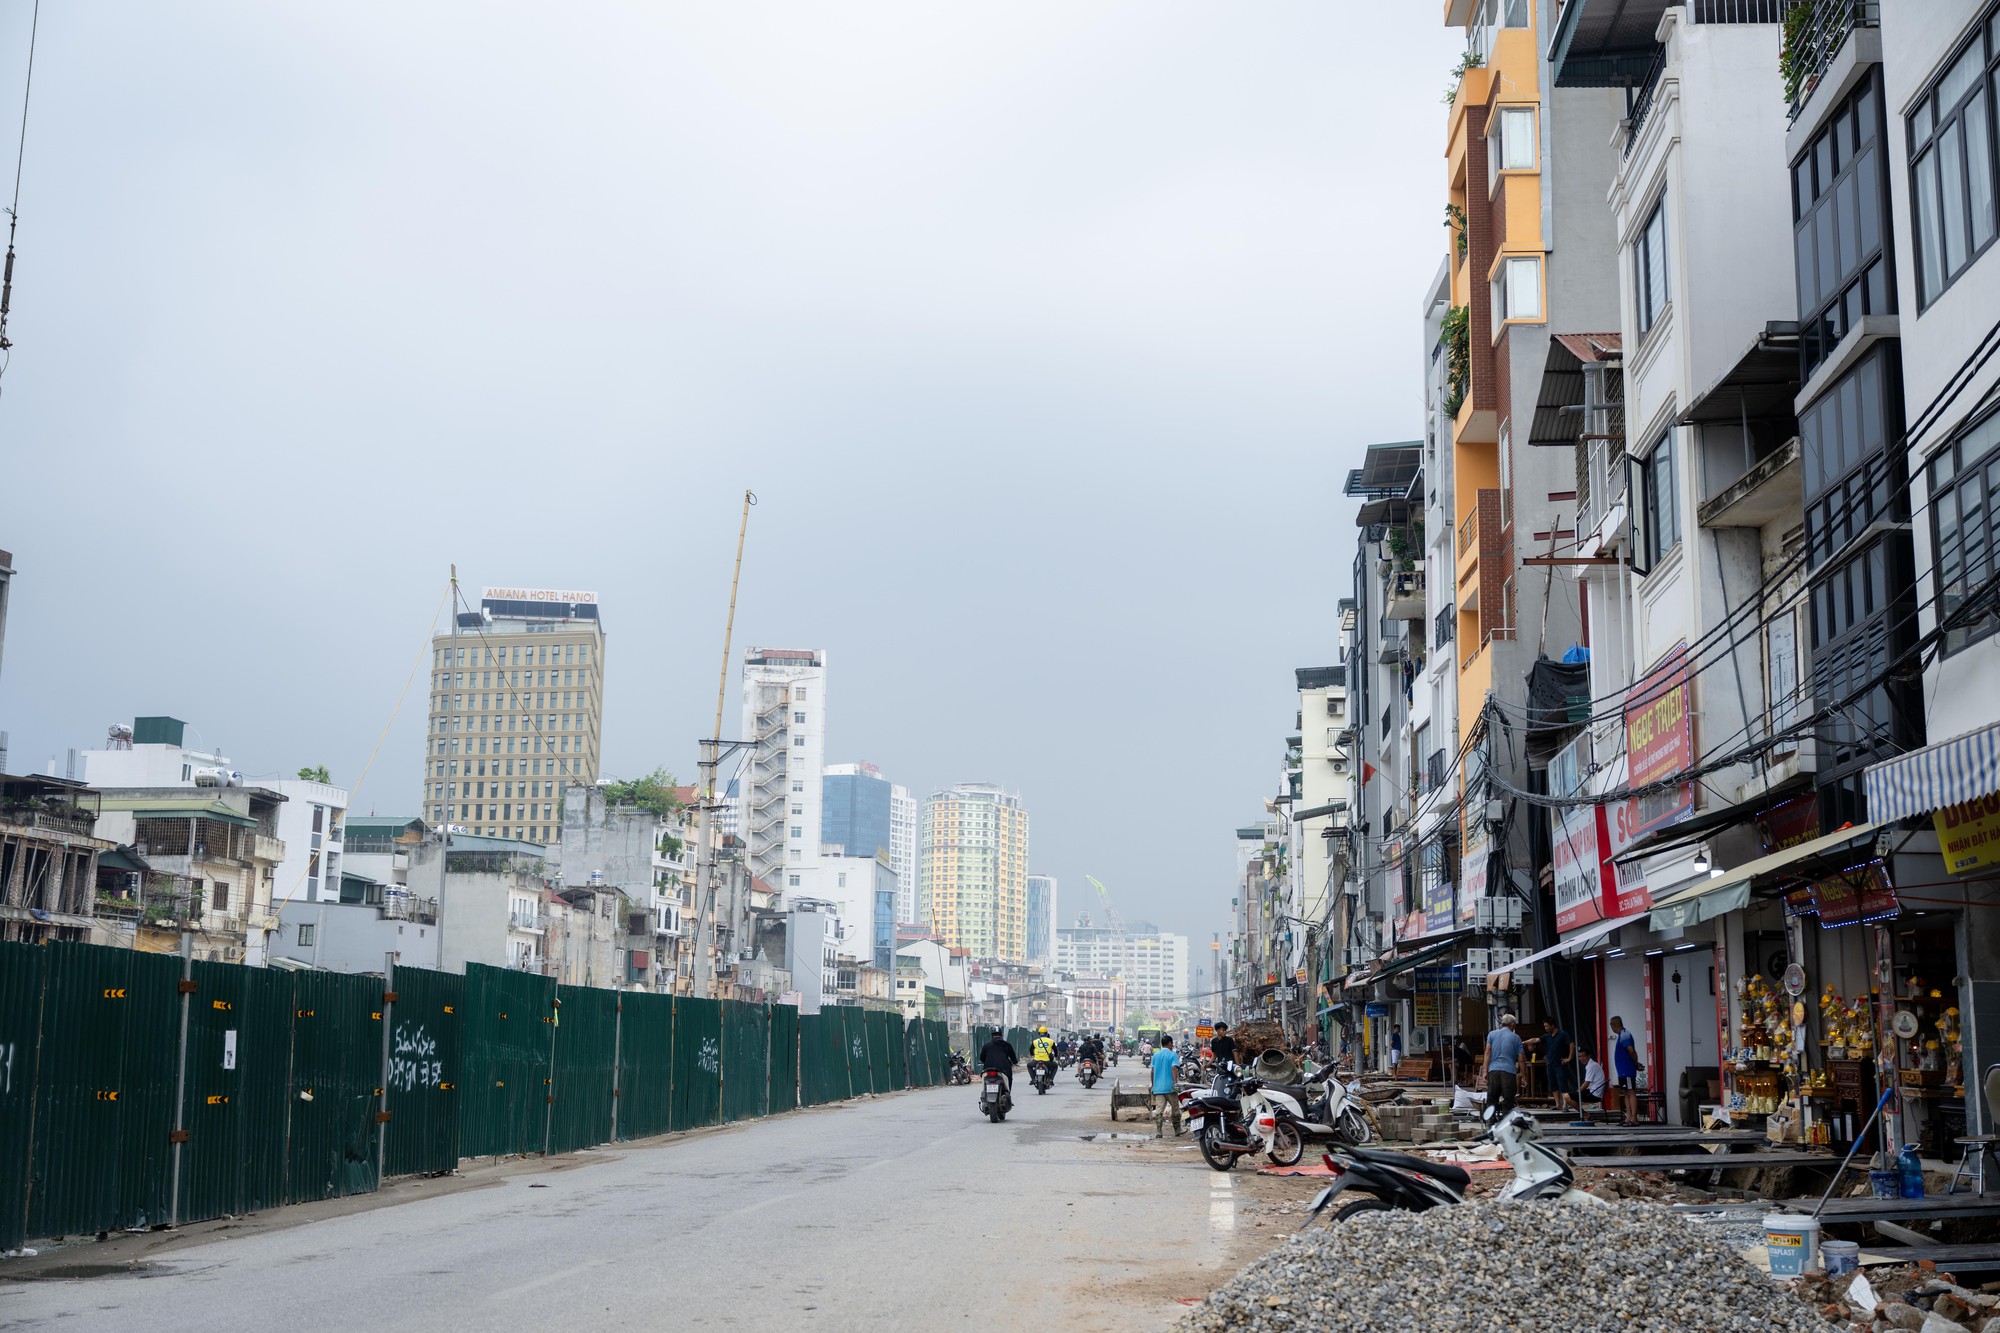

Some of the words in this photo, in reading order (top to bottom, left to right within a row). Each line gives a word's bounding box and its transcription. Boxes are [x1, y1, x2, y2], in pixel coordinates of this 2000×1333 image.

[486, 588, 527, 600] AMIANA
[530, 590, 559, 601] HOTEL
[562, 592, 595, 602] HANOI
[1947, 837, 1971, 854] NHẬN
[1577, 868, 1597, 898] LONG
[1037, 1040, 1050, 1049] be
